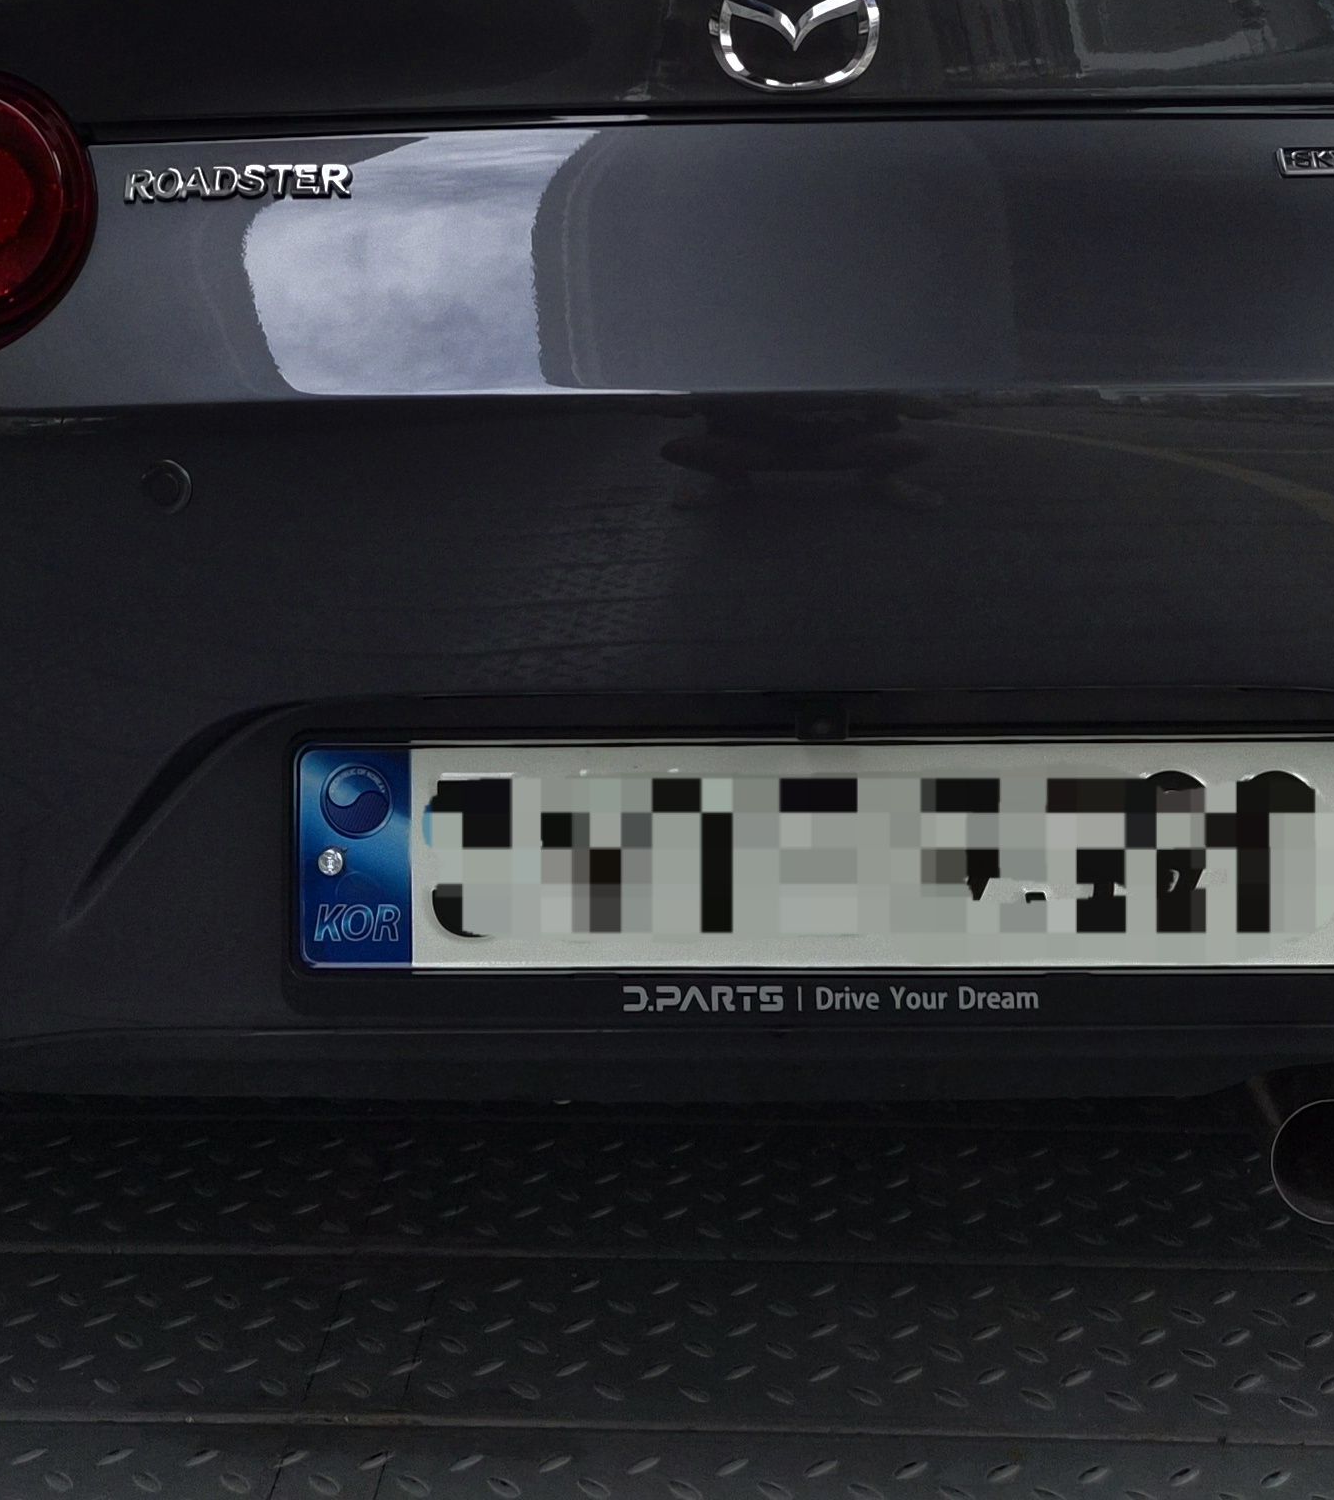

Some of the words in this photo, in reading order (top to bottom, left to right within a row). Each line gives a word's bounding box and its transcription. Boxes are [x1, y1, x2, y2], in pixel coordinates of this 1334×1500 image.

[123, 163, 353, 204] ROADSTER
[314, 903, 401, 942] KOR
[815, 985, 880, 1010] Drive
[889, 986, 948, 1010] Your
[958, 986, 1039, 1010] Dream
